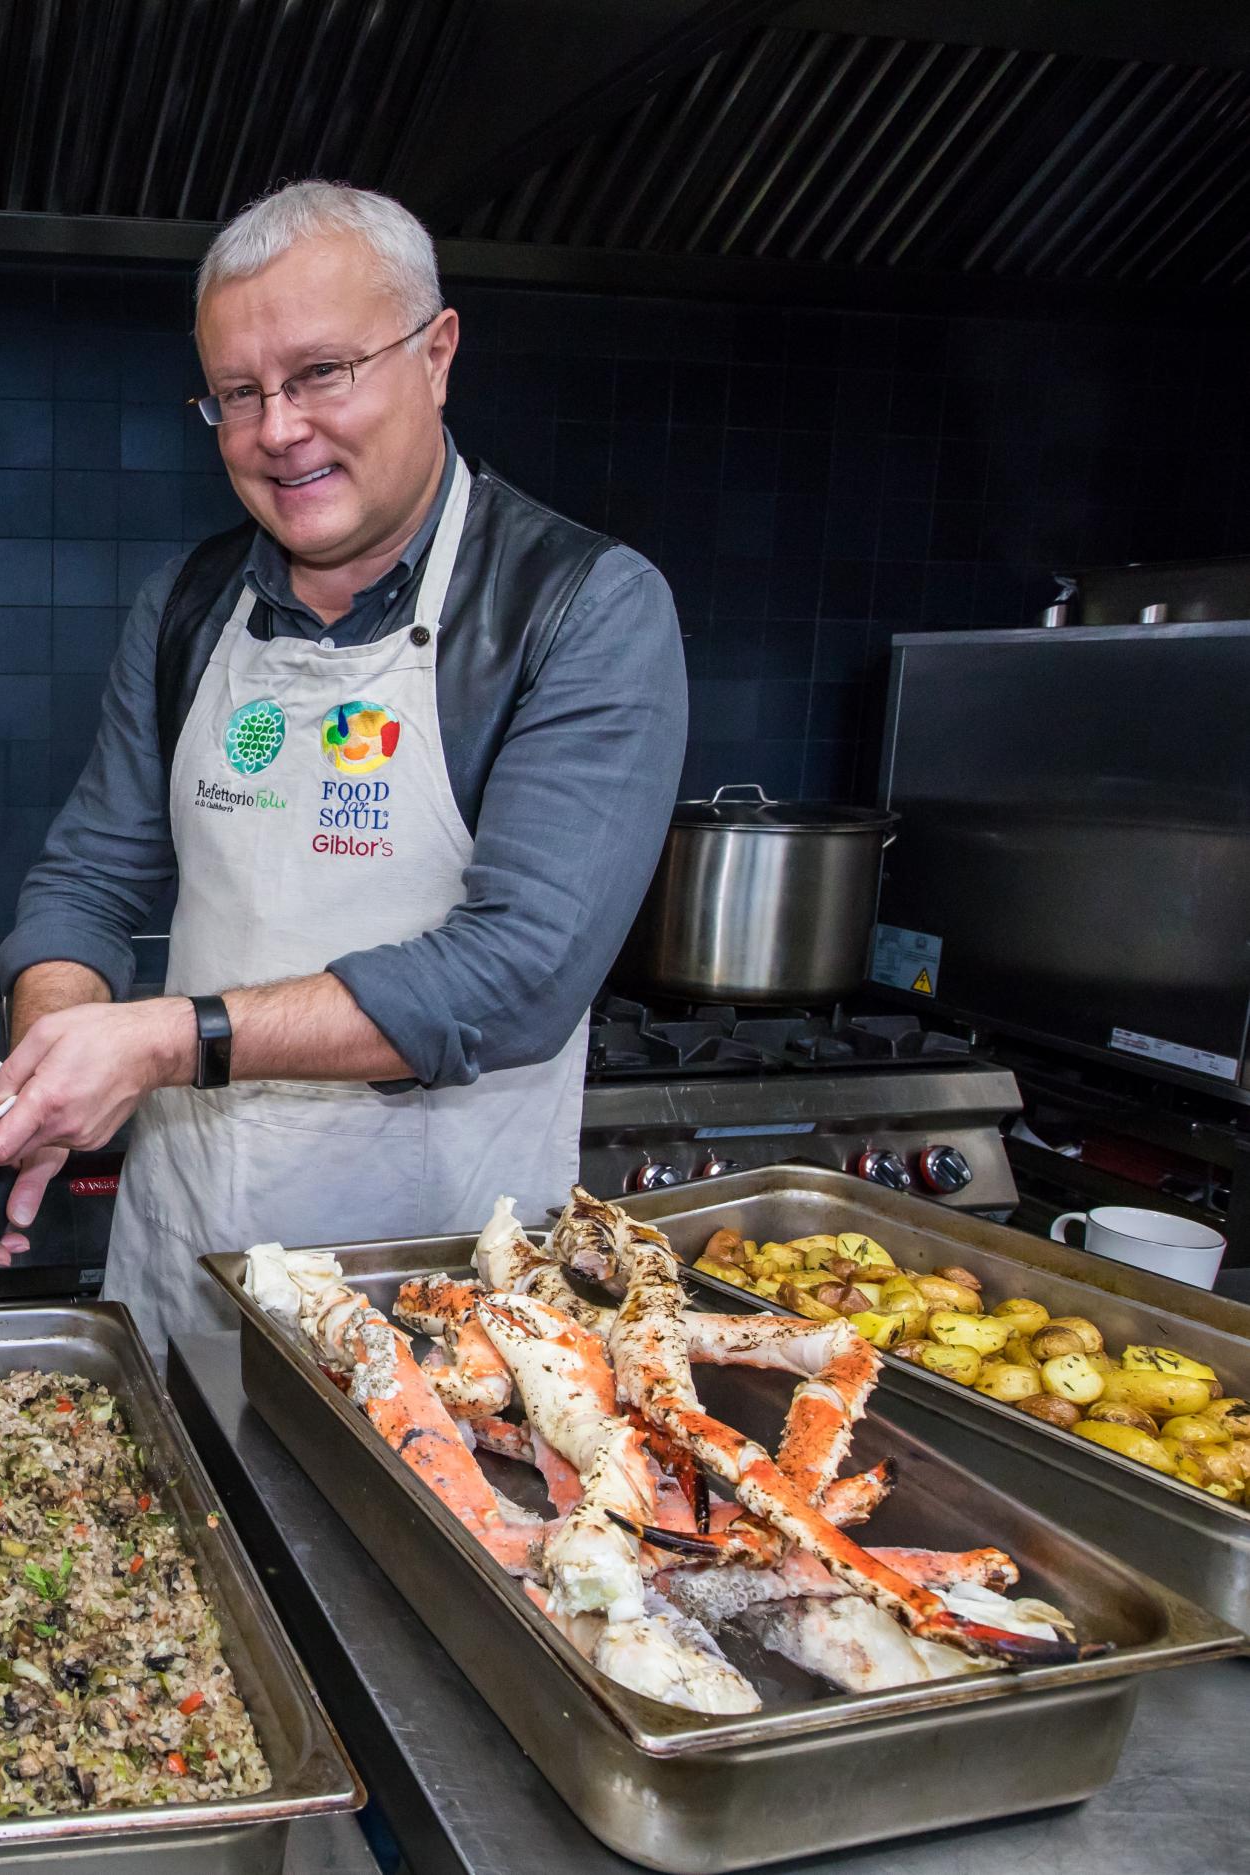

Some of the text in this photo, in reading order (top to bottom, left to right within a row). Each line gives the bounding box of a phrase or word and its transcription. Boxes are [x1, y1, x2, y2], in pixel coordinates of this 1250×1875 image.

[196, 779, 254, 806] Refettorio
[321, 781, 390, 802] FOOD
[338, 800, 369, 816] for
[312, 834, 393, 857] Giblor's
